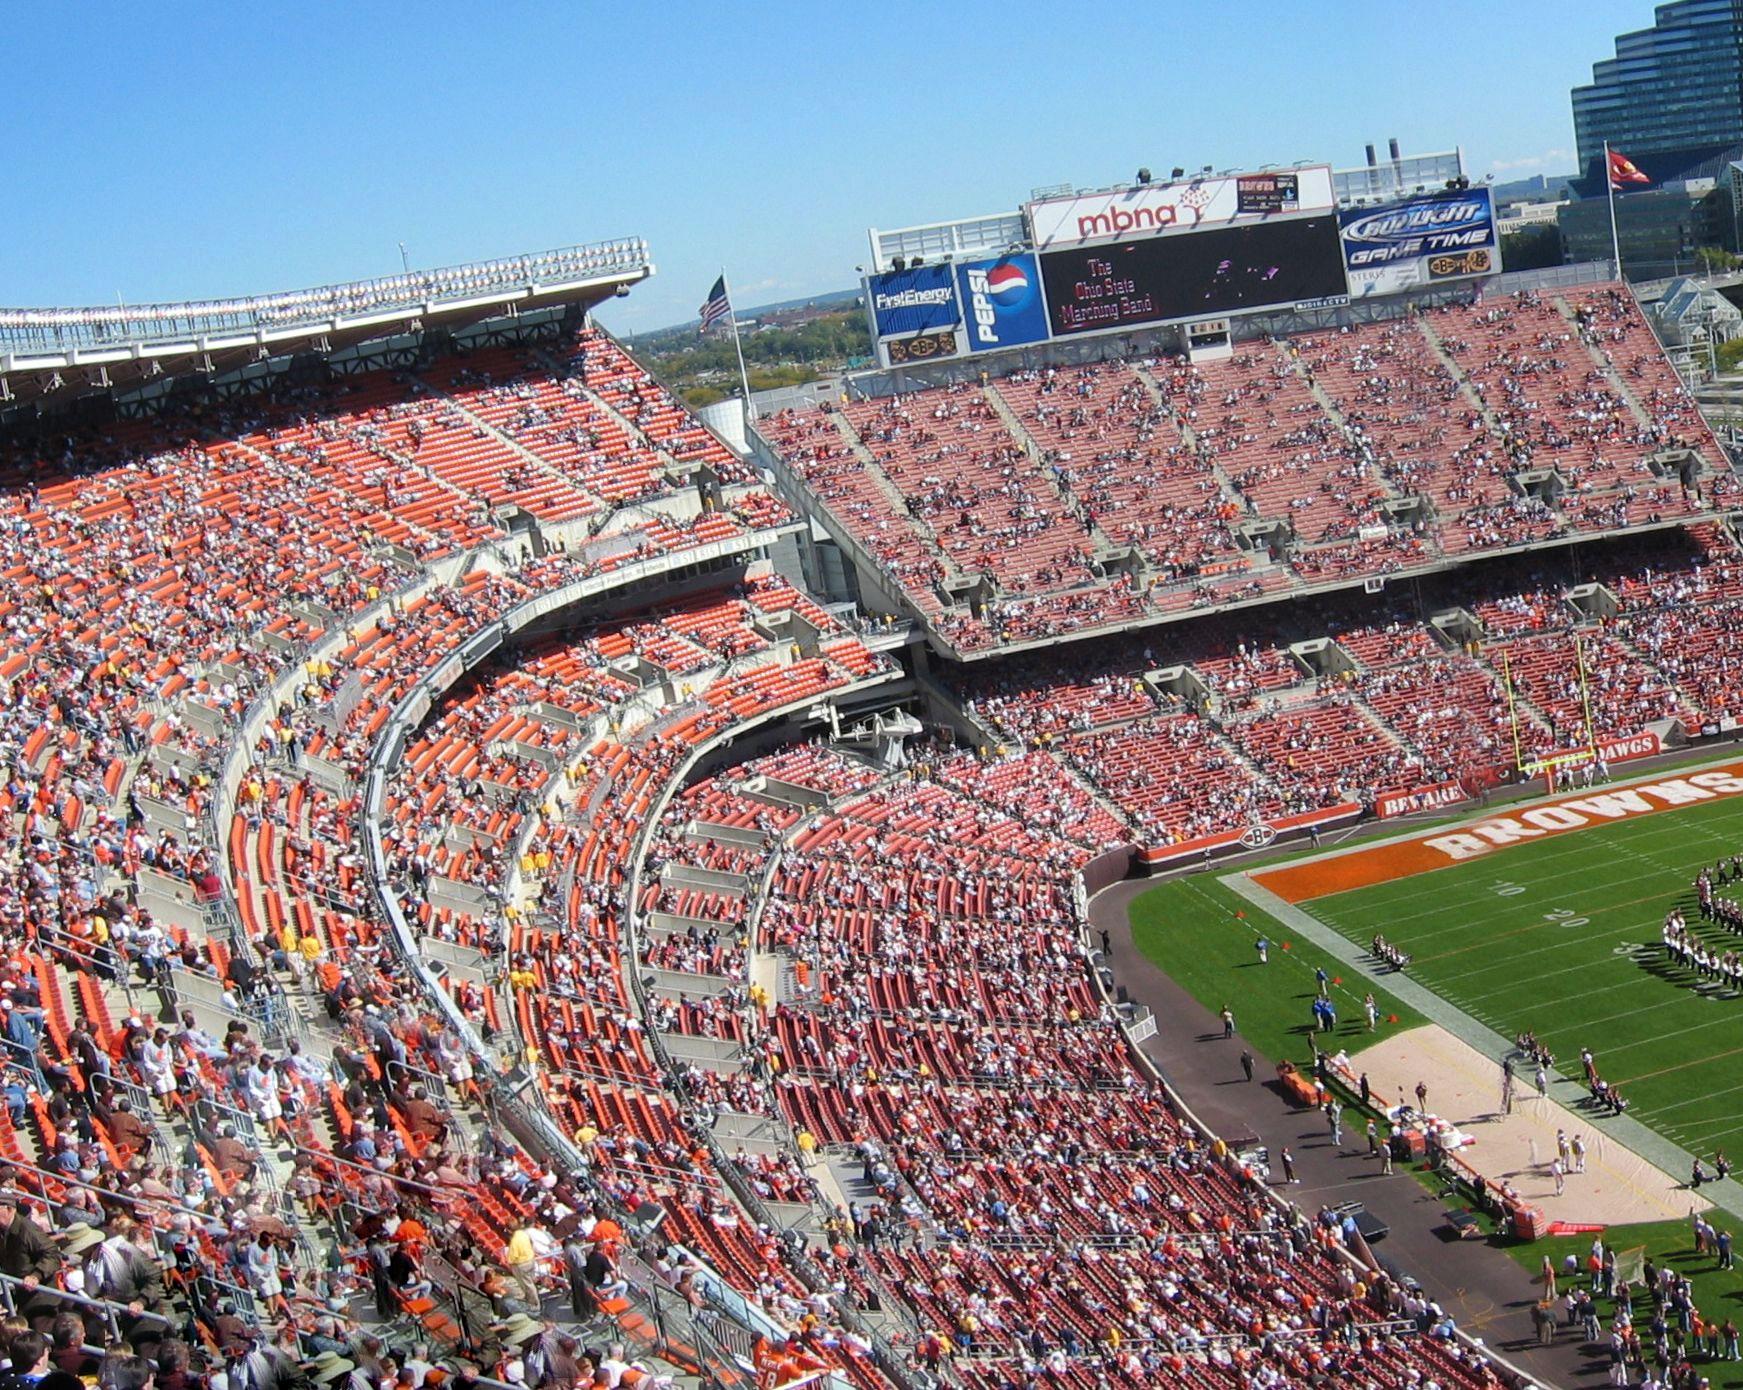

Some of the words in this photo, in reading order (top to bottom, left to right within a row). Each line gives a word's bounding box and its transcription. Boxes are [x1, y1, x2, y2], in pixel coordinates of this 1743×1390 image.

[1077, 203, 1176, 237] mbna
[1362, 216, 1408, 238] BUD
[1408, 202, 1482, 227] LIGHT
[1350, 238, 1421, 265] GAME
[1430, 229, 1490, 249] TIME
[1087, 258, 1113, 277] The
[876, 287, 953, 309] FirstEnergy
[1073, 280, 1103, 300] Ohio
[1104, 276, 1136, 297] State
[967, 269, 999, 343] PEPSI
[1060, 300, 1120, 324] Marching
[1120, 293, 1153, 315] Band
[1543, 908, 1591, 928] 20
